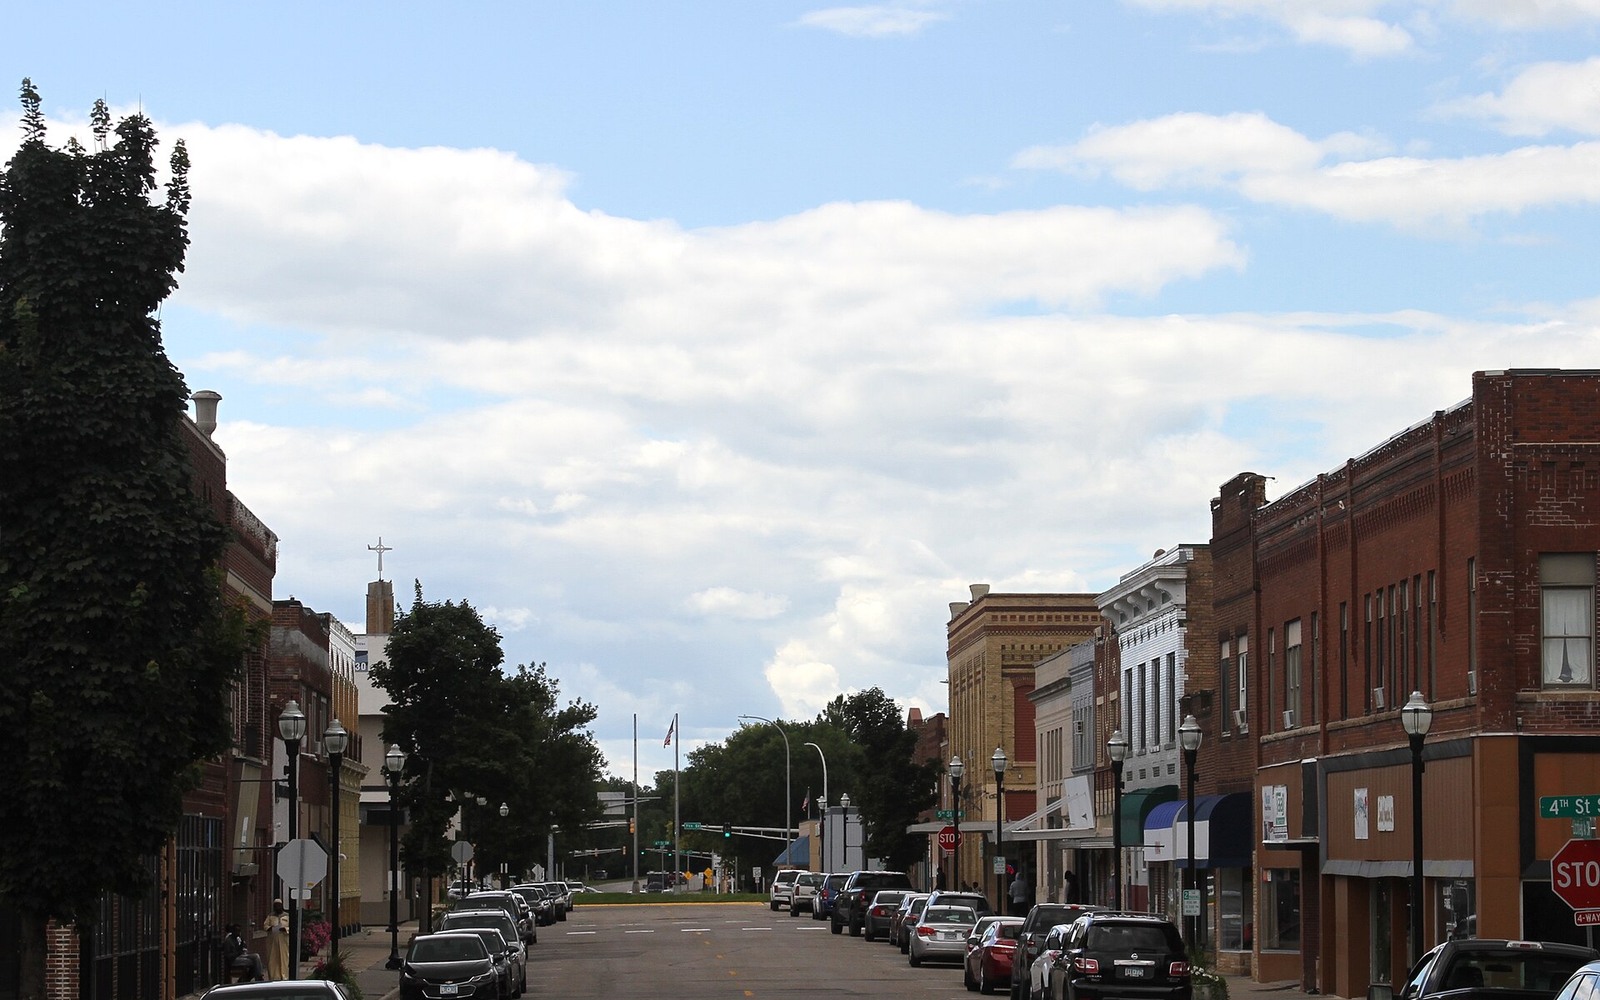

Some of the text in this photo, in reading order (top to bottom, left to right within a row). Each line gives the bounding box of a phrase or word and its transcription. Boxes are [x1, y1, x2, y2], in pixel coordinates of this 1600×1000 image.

[1549, 799, 1569, 815] 4TH
[1575, 799, 1590, 814] St
[1557, 861, 1600, 888] STO
[1577, 912, 1600, 923] 4-WAY
